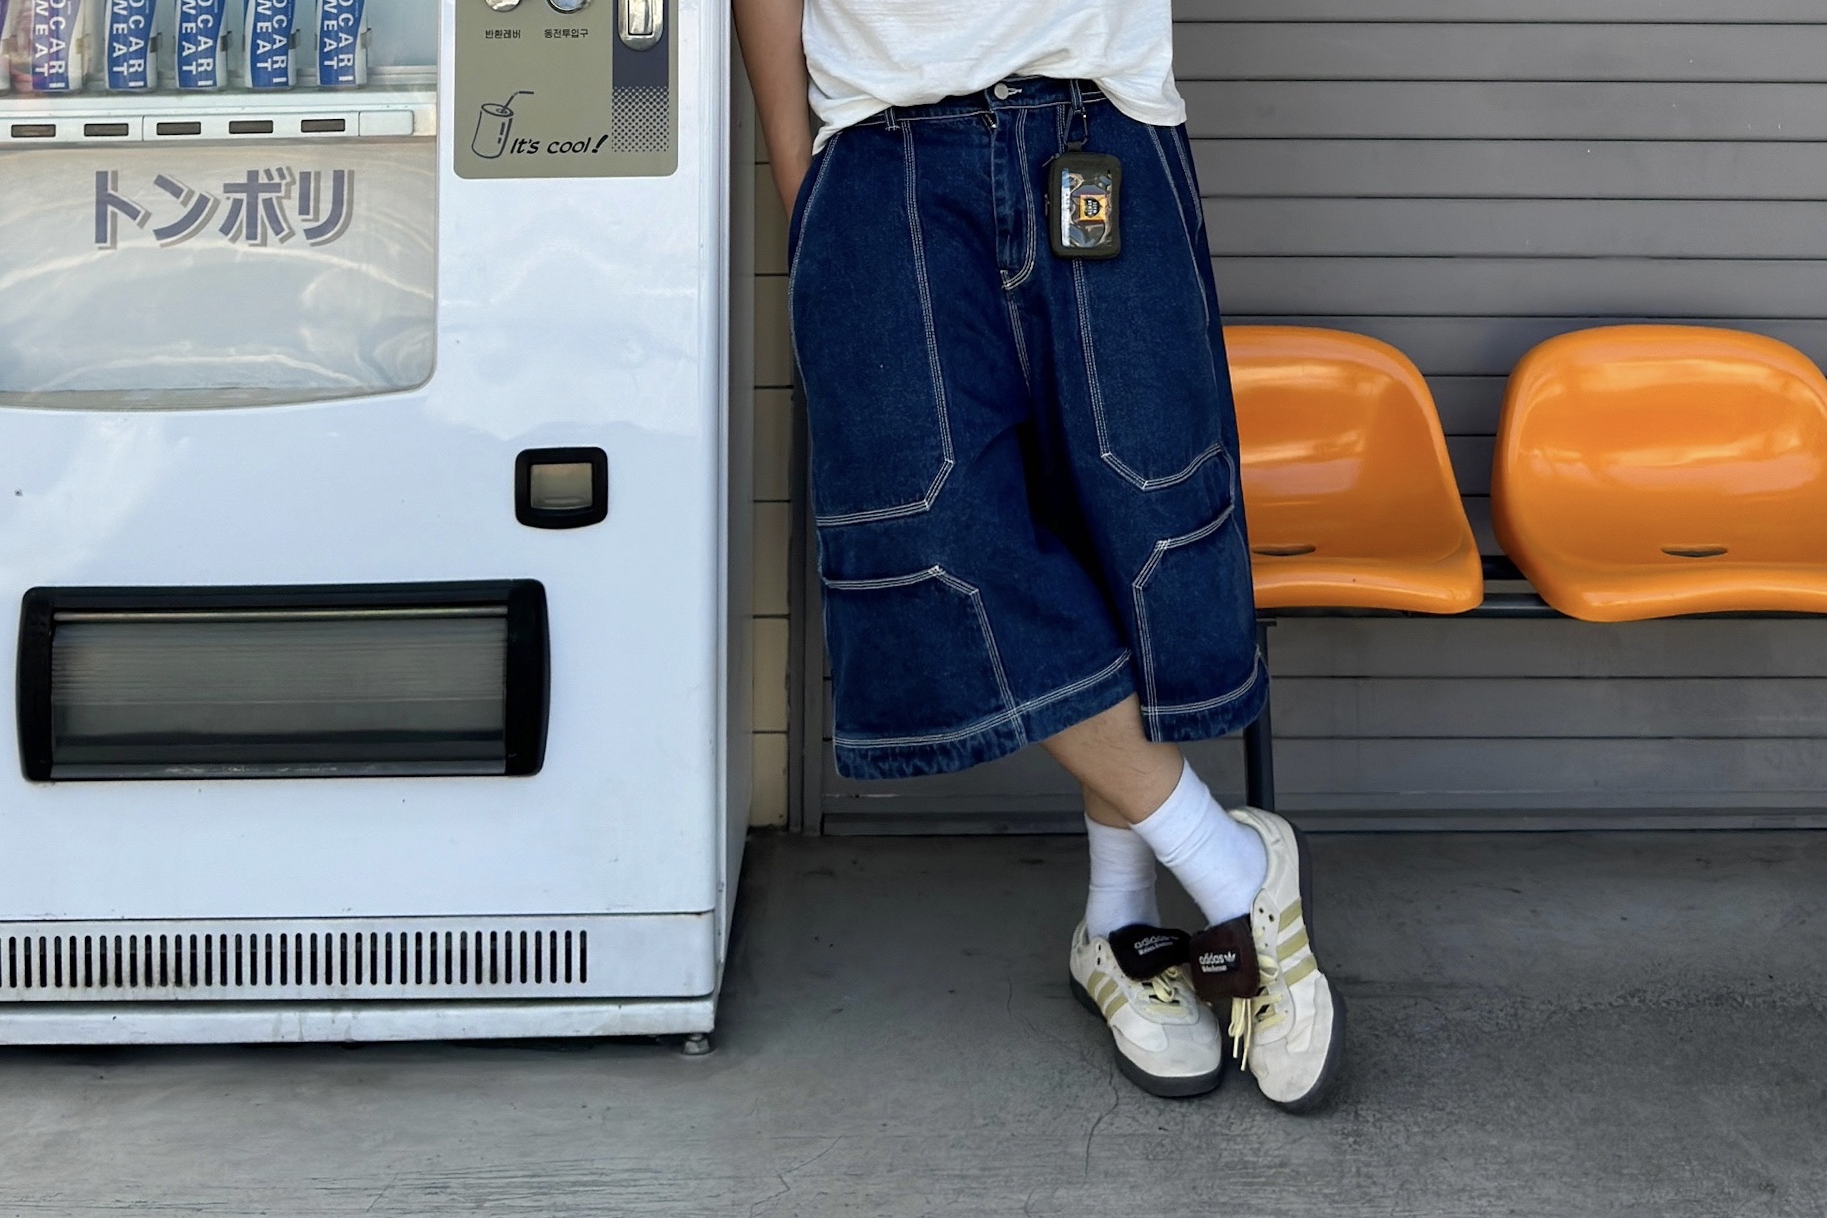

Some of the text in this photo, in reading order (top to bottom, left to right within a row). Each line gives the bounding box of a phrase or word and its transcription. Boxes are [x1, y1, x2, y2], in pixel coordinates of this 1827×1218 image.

[544, 28, 589, 39] 동전투입구
[510, 138, 541, 154] It's
[95, 167, 354, 249] トンボリ
